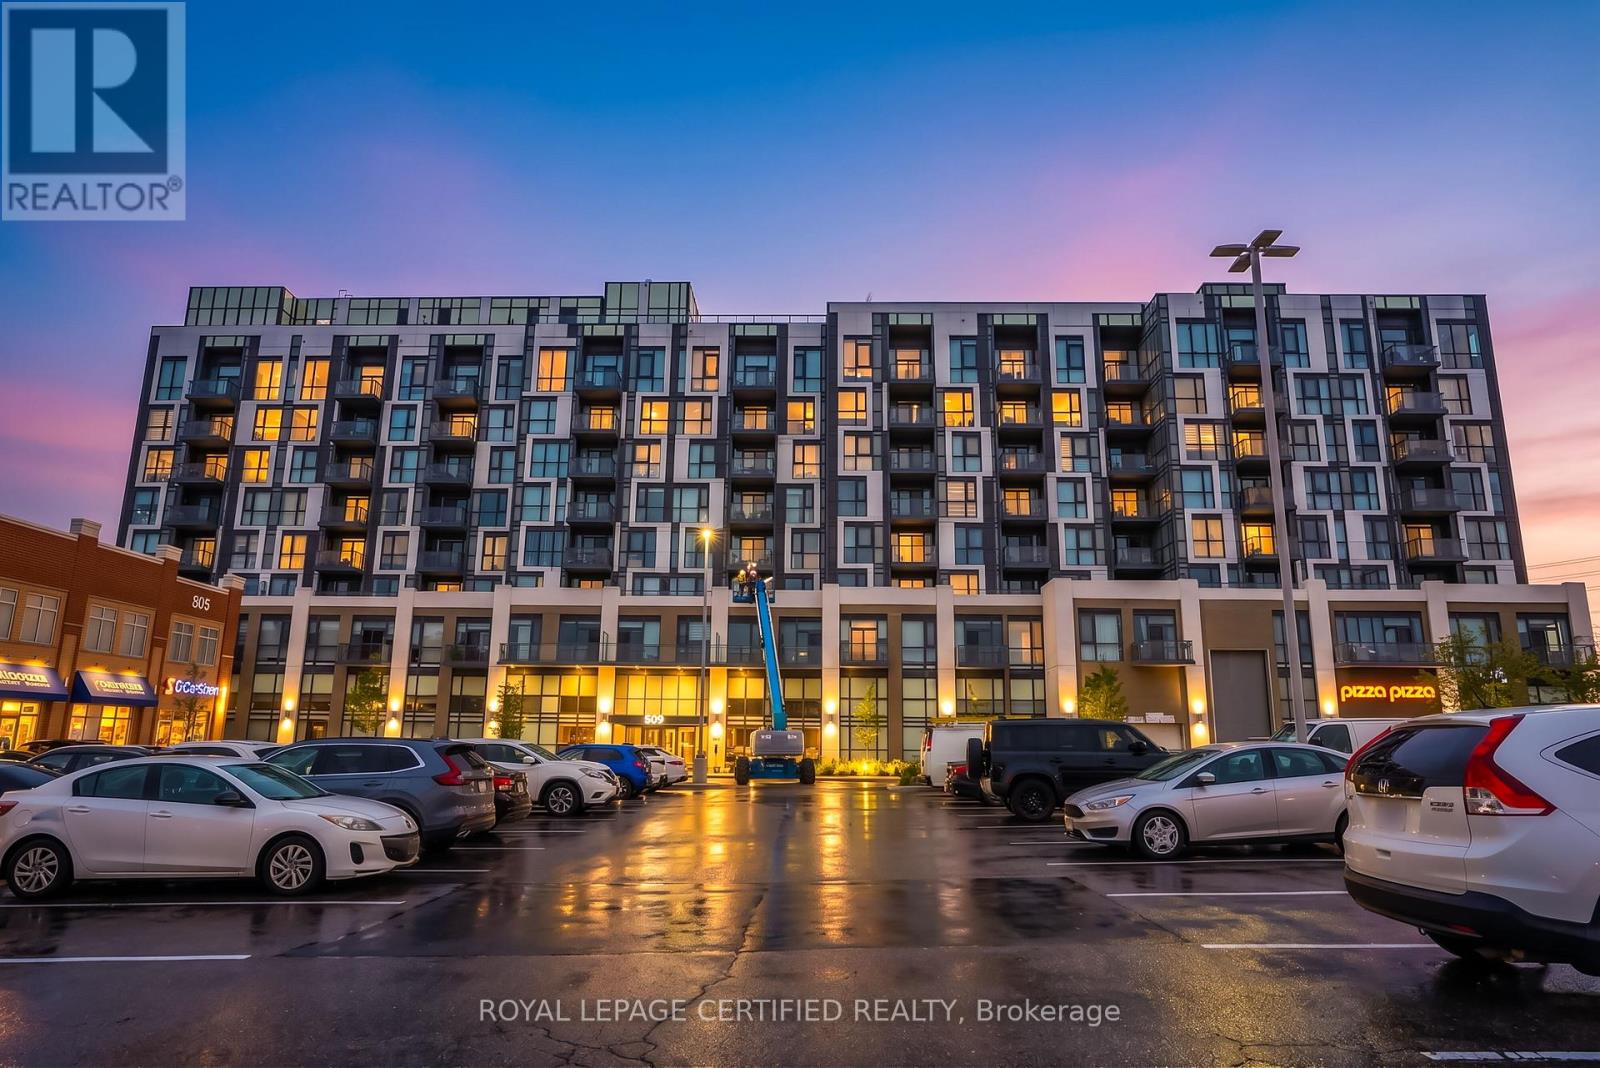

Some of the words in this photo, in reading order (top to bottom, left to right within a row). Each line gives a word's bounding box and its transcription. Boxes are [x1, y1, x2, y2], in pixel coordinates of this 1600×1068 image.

[192, 595, 211, 611] 805
[1340, 685, 1387, 702] pizza
[1389, 685, 1436, 702] pizza
[644, 714, 665, 724] 509
